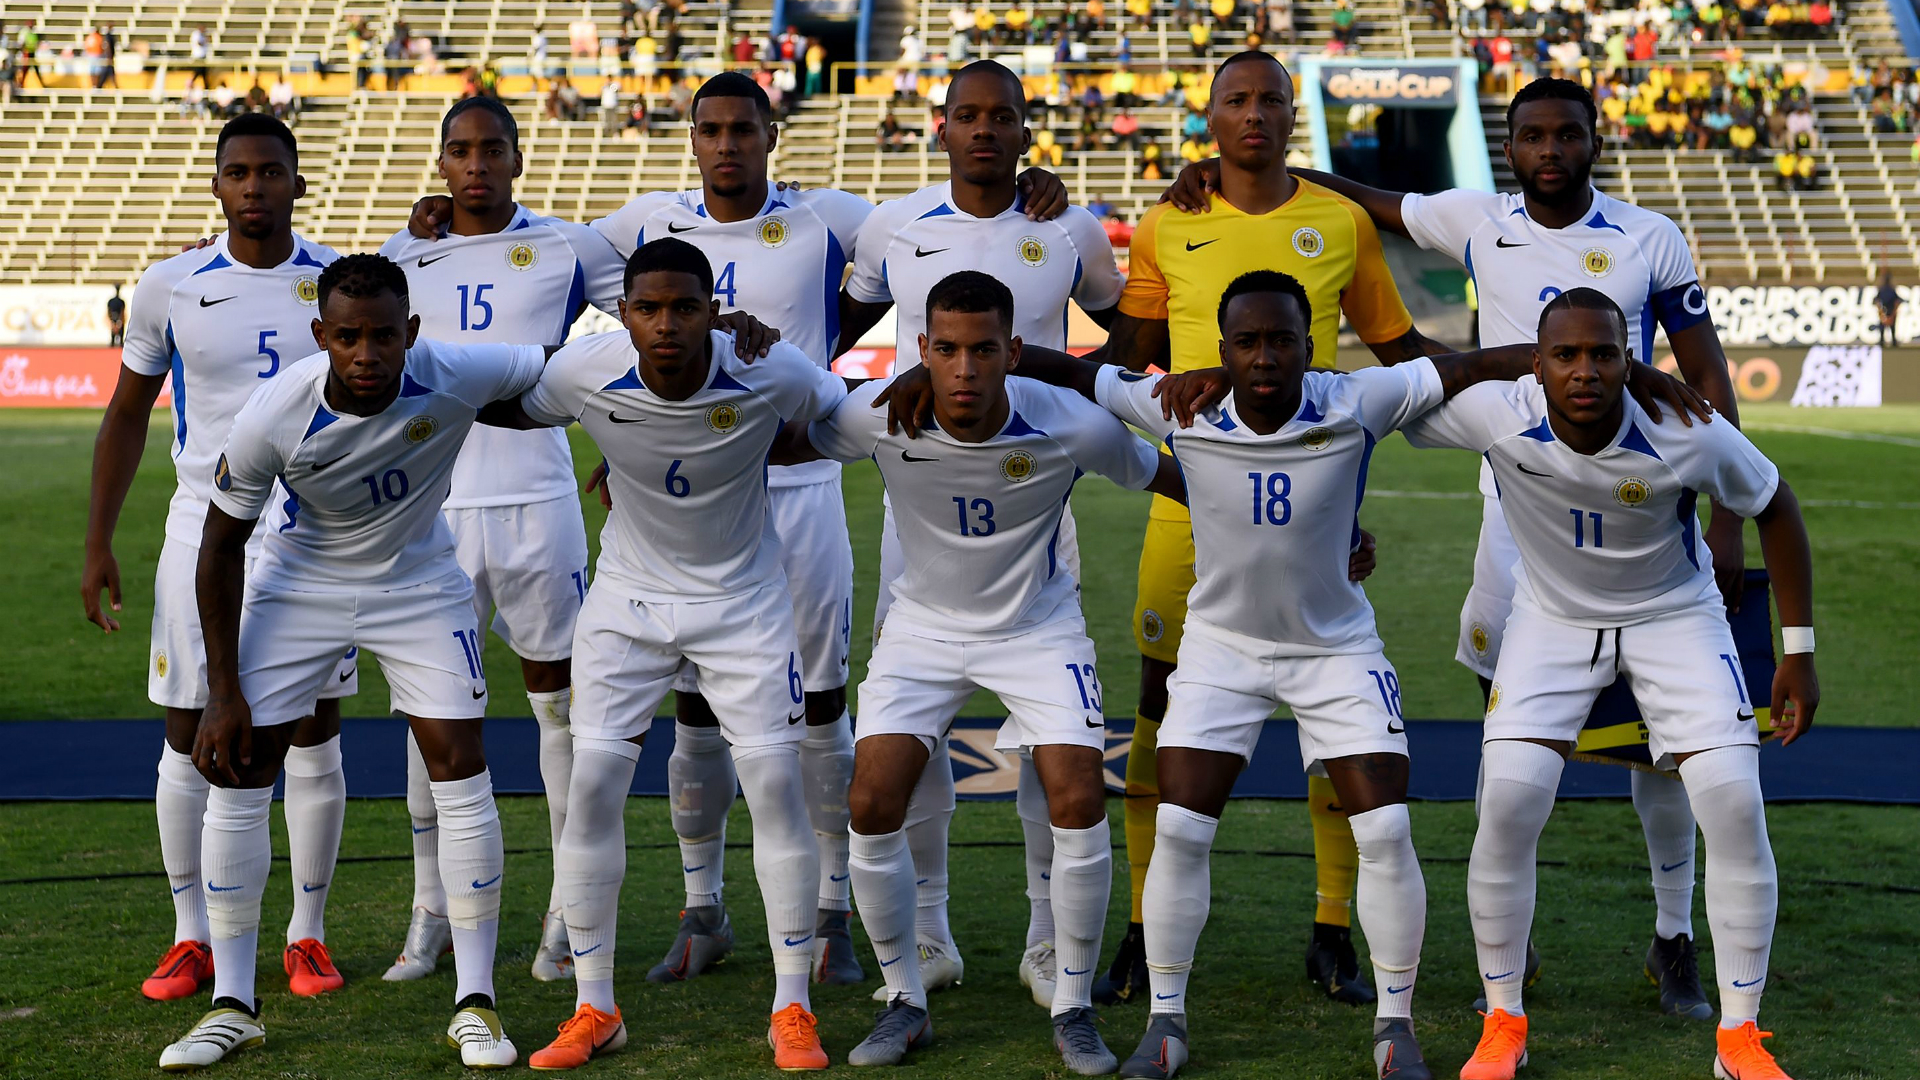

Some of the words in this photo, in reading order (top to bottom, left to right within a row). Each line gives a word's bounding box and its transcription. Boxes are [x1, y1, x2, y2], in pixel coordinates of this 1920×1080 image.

[456, 282, 494, 331] 15
[714, 261, 737, 308] 4
[1683, 283, 1707, 316] C
[3, 306, 96, 331] COPA
[257, 330, 282, 379] 5
[361, 467, 409, 506] 10
[665, 460, 690, 498] 6
[1248, 471, 1292, 526] 18
[953, 496, 996, 536] 13
[1569, 508, 1604, 549] 11
[842, 597, 850, 645] 4
[788, 651, 803, 704] 6
[1065, 662, 1102, 714] 13
[1367, 670, 1404, 721] 18
